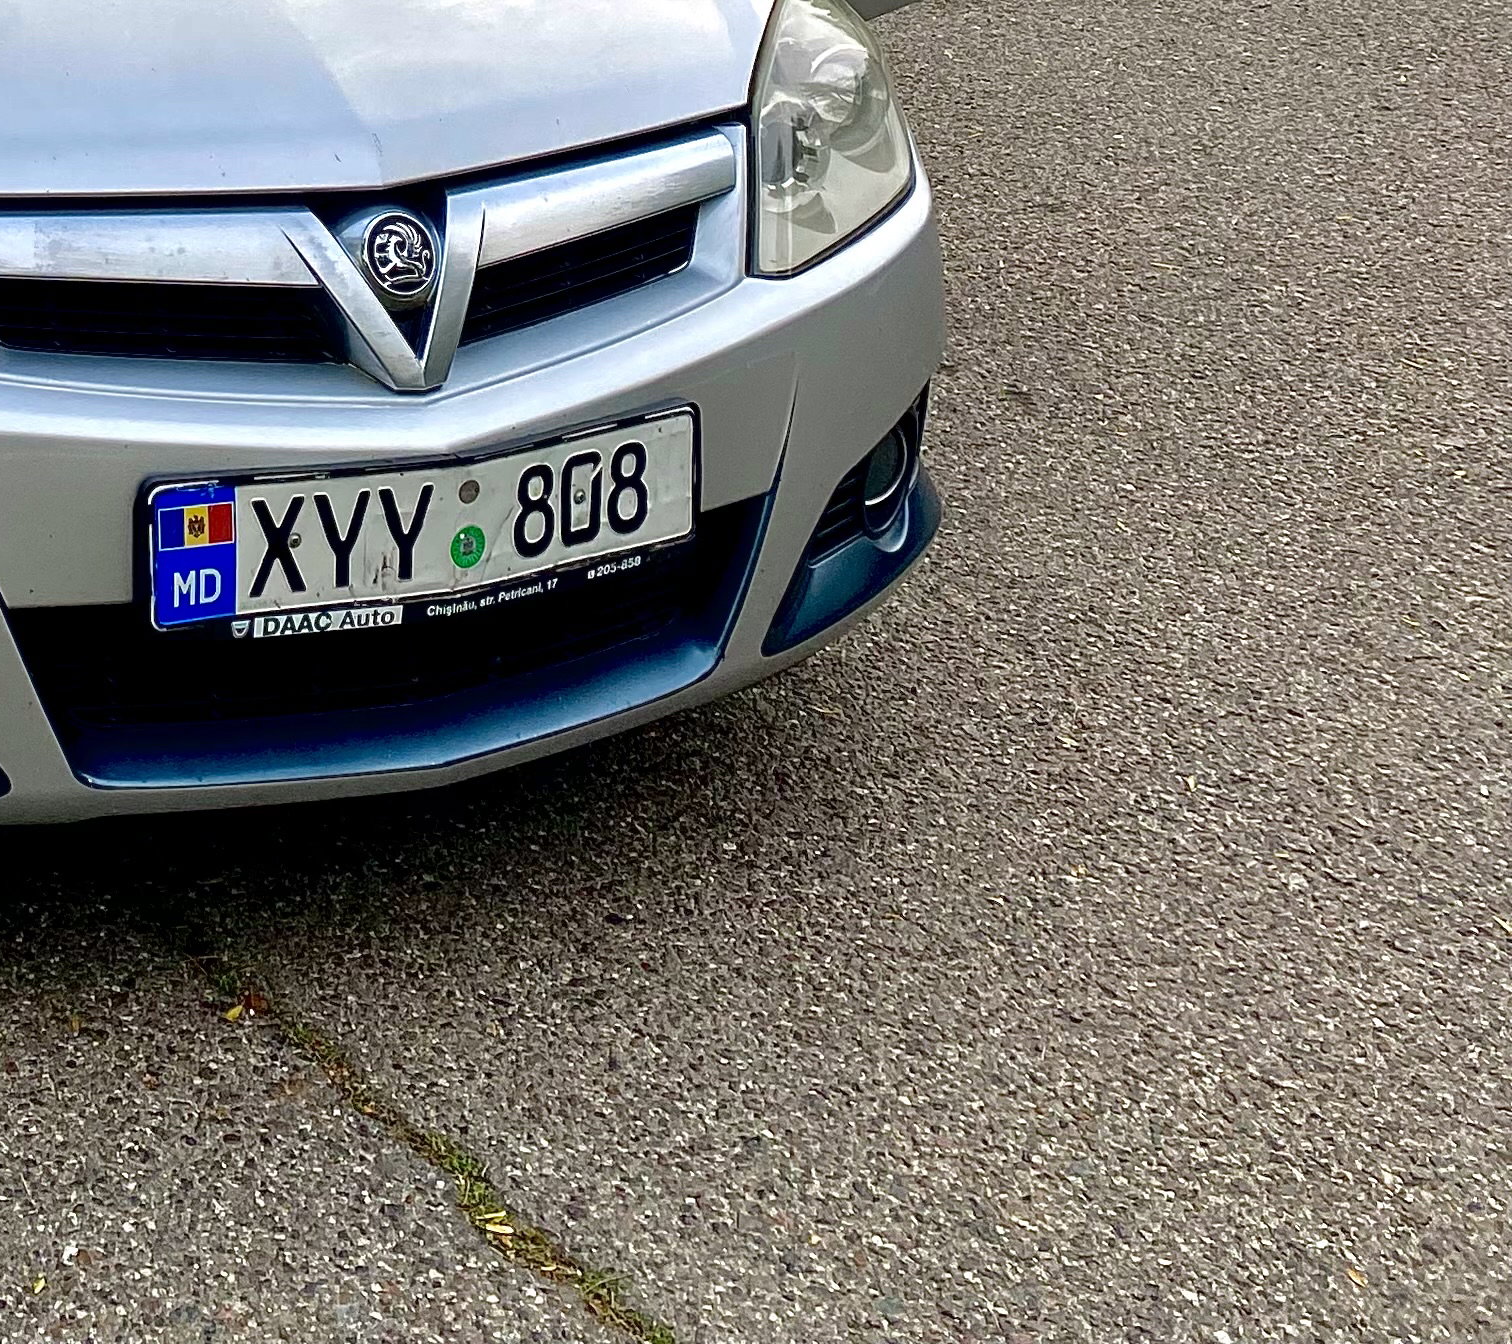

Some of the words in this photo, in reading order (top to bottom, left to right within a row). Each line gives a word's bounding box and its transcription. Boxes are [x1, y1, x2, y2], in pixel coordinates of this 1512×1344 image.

[249, 483, 434, 599] XYY
[513, 440, 649, 559] 808
[171, 568, 222, 608] MD
[546, 578, 558, 591] 17
[263, 611, 332, 637] DAAC
[338, 609, 395, 629] Auto
